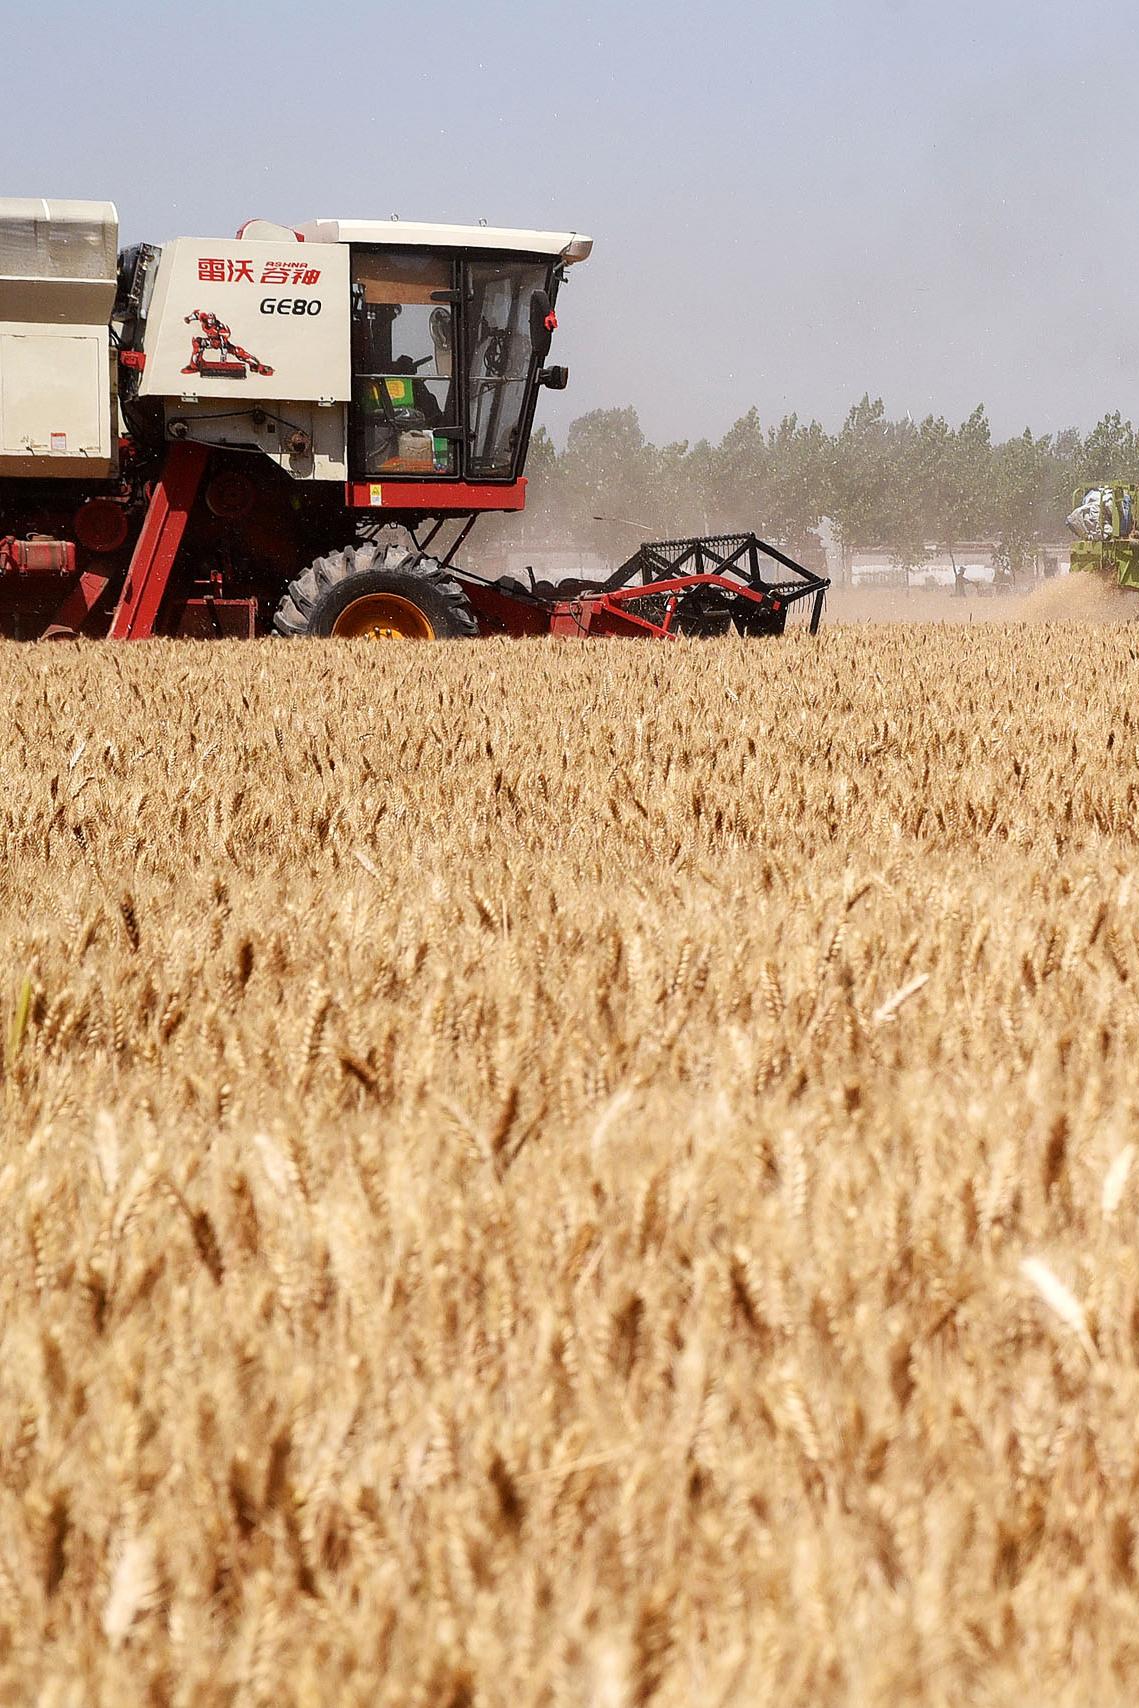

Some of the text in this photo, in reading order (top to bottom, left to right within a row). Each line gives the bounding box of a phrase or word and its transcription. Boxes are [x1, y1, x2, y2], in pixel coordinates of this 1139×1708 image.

[198, 258, 322, 285] 雷沃 谷神
[259, 298, 322, 316] GE80
